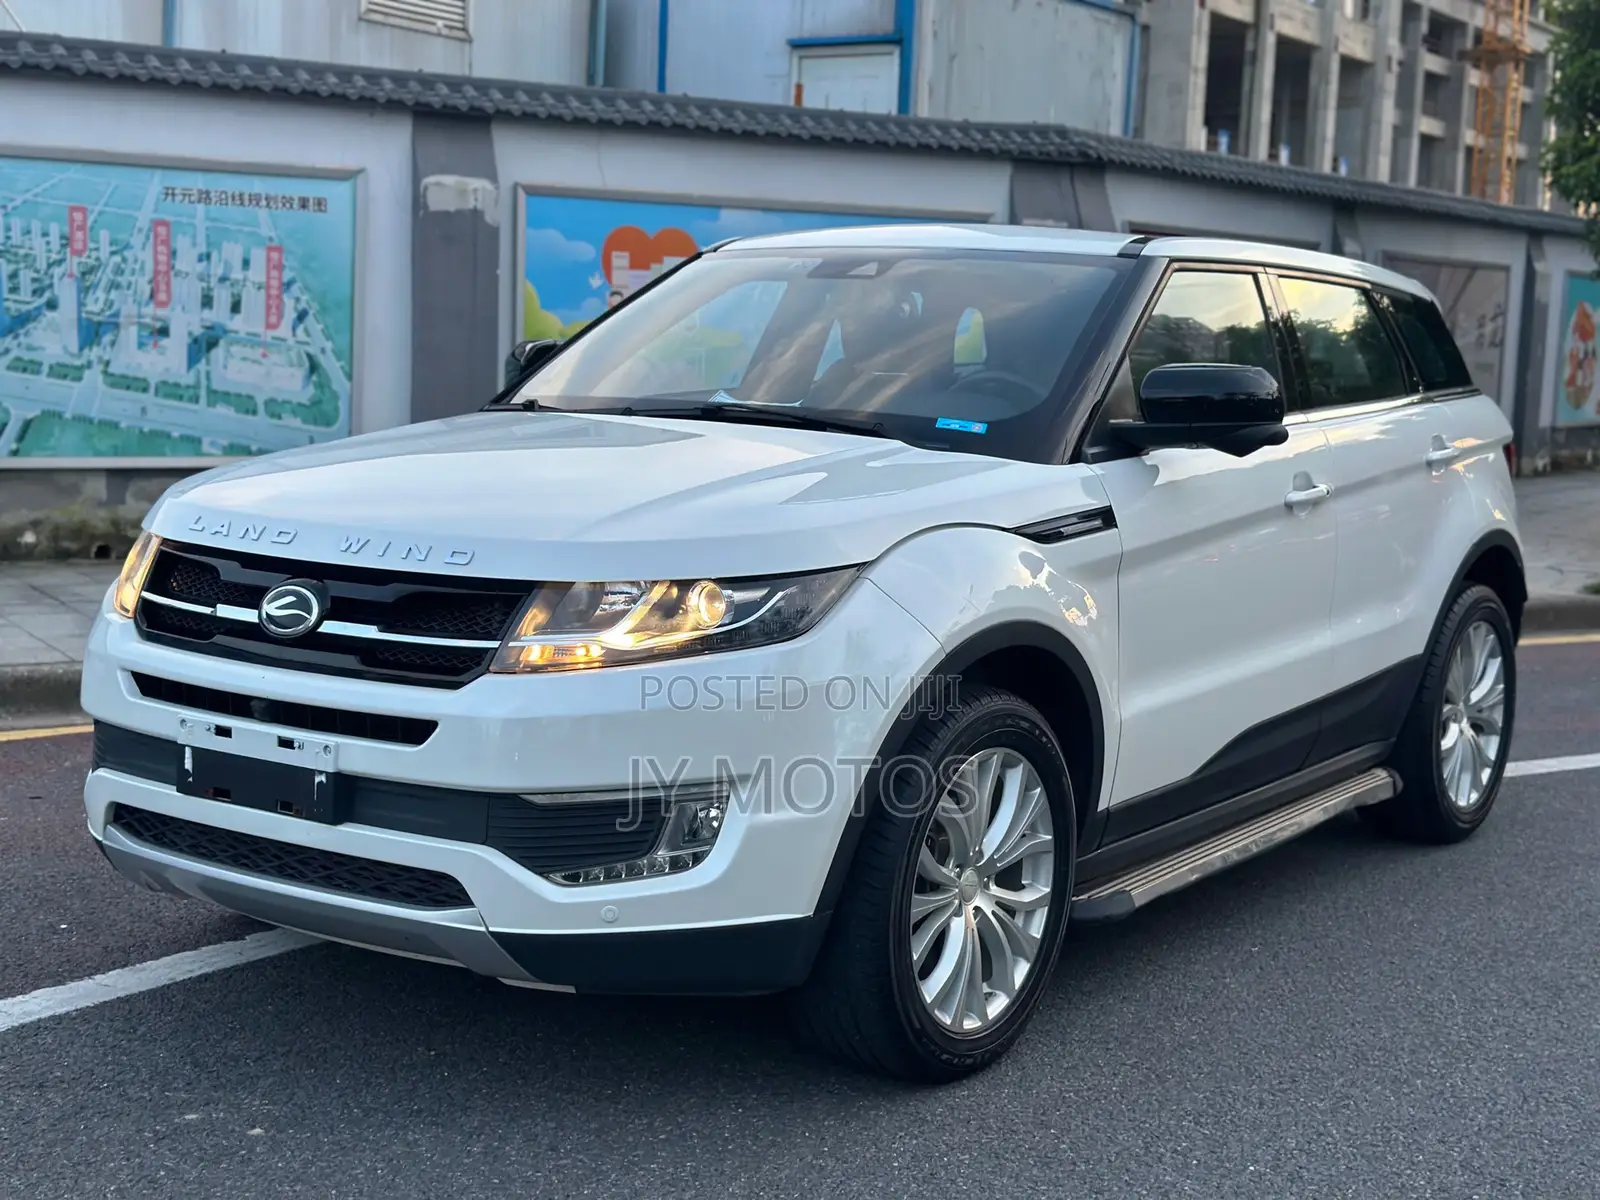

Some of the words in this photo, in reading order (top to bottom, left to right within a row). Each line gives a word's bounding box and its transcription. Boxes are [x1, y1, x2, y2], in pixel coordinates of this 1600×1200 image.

[163, 186, 328, 212] 开元路沿线规划效果图
[188, 515, 298, 545] LAND
[339, 534, 476, 567] WIND
